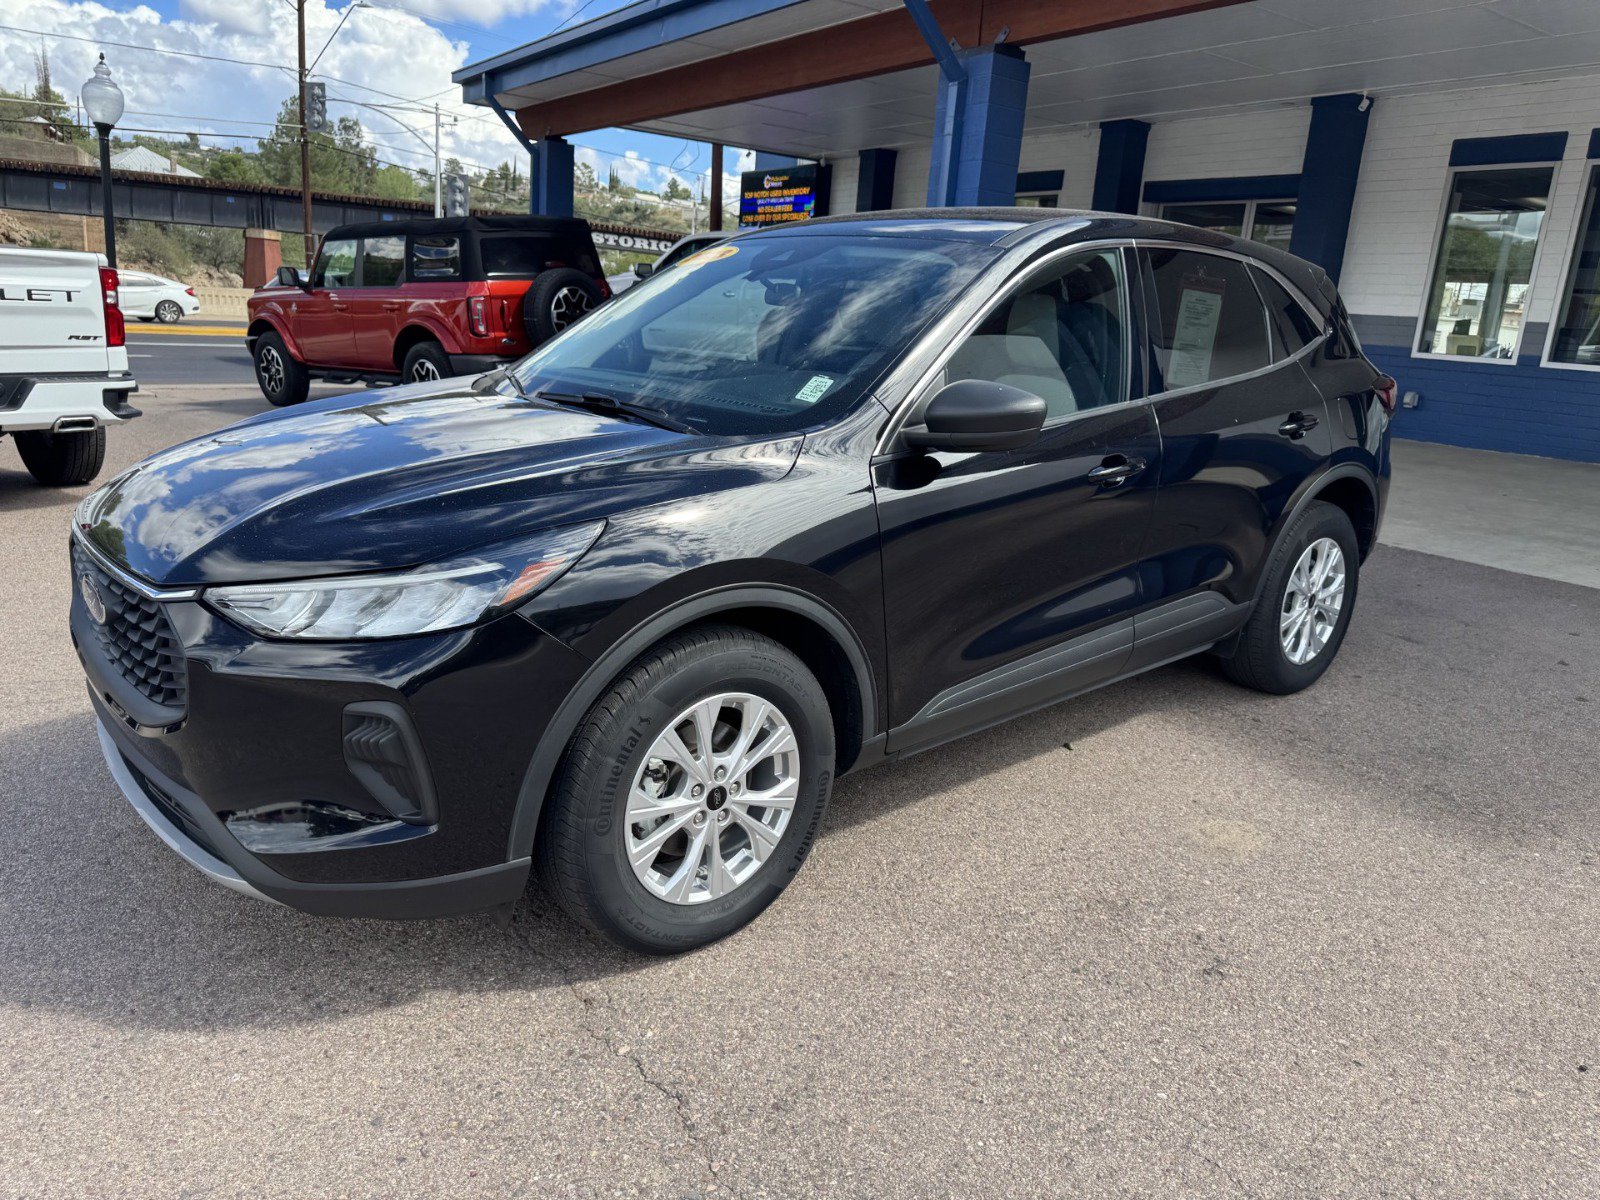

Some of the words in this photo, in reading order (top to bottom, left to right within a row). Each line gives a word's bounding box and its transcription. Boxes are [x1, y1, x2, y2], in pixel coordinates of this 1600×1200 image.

[782, 187, 811, 196] INVENTORY
[594, 726, 643, 837] Continental
[792, 770, 830, 862] Continental
